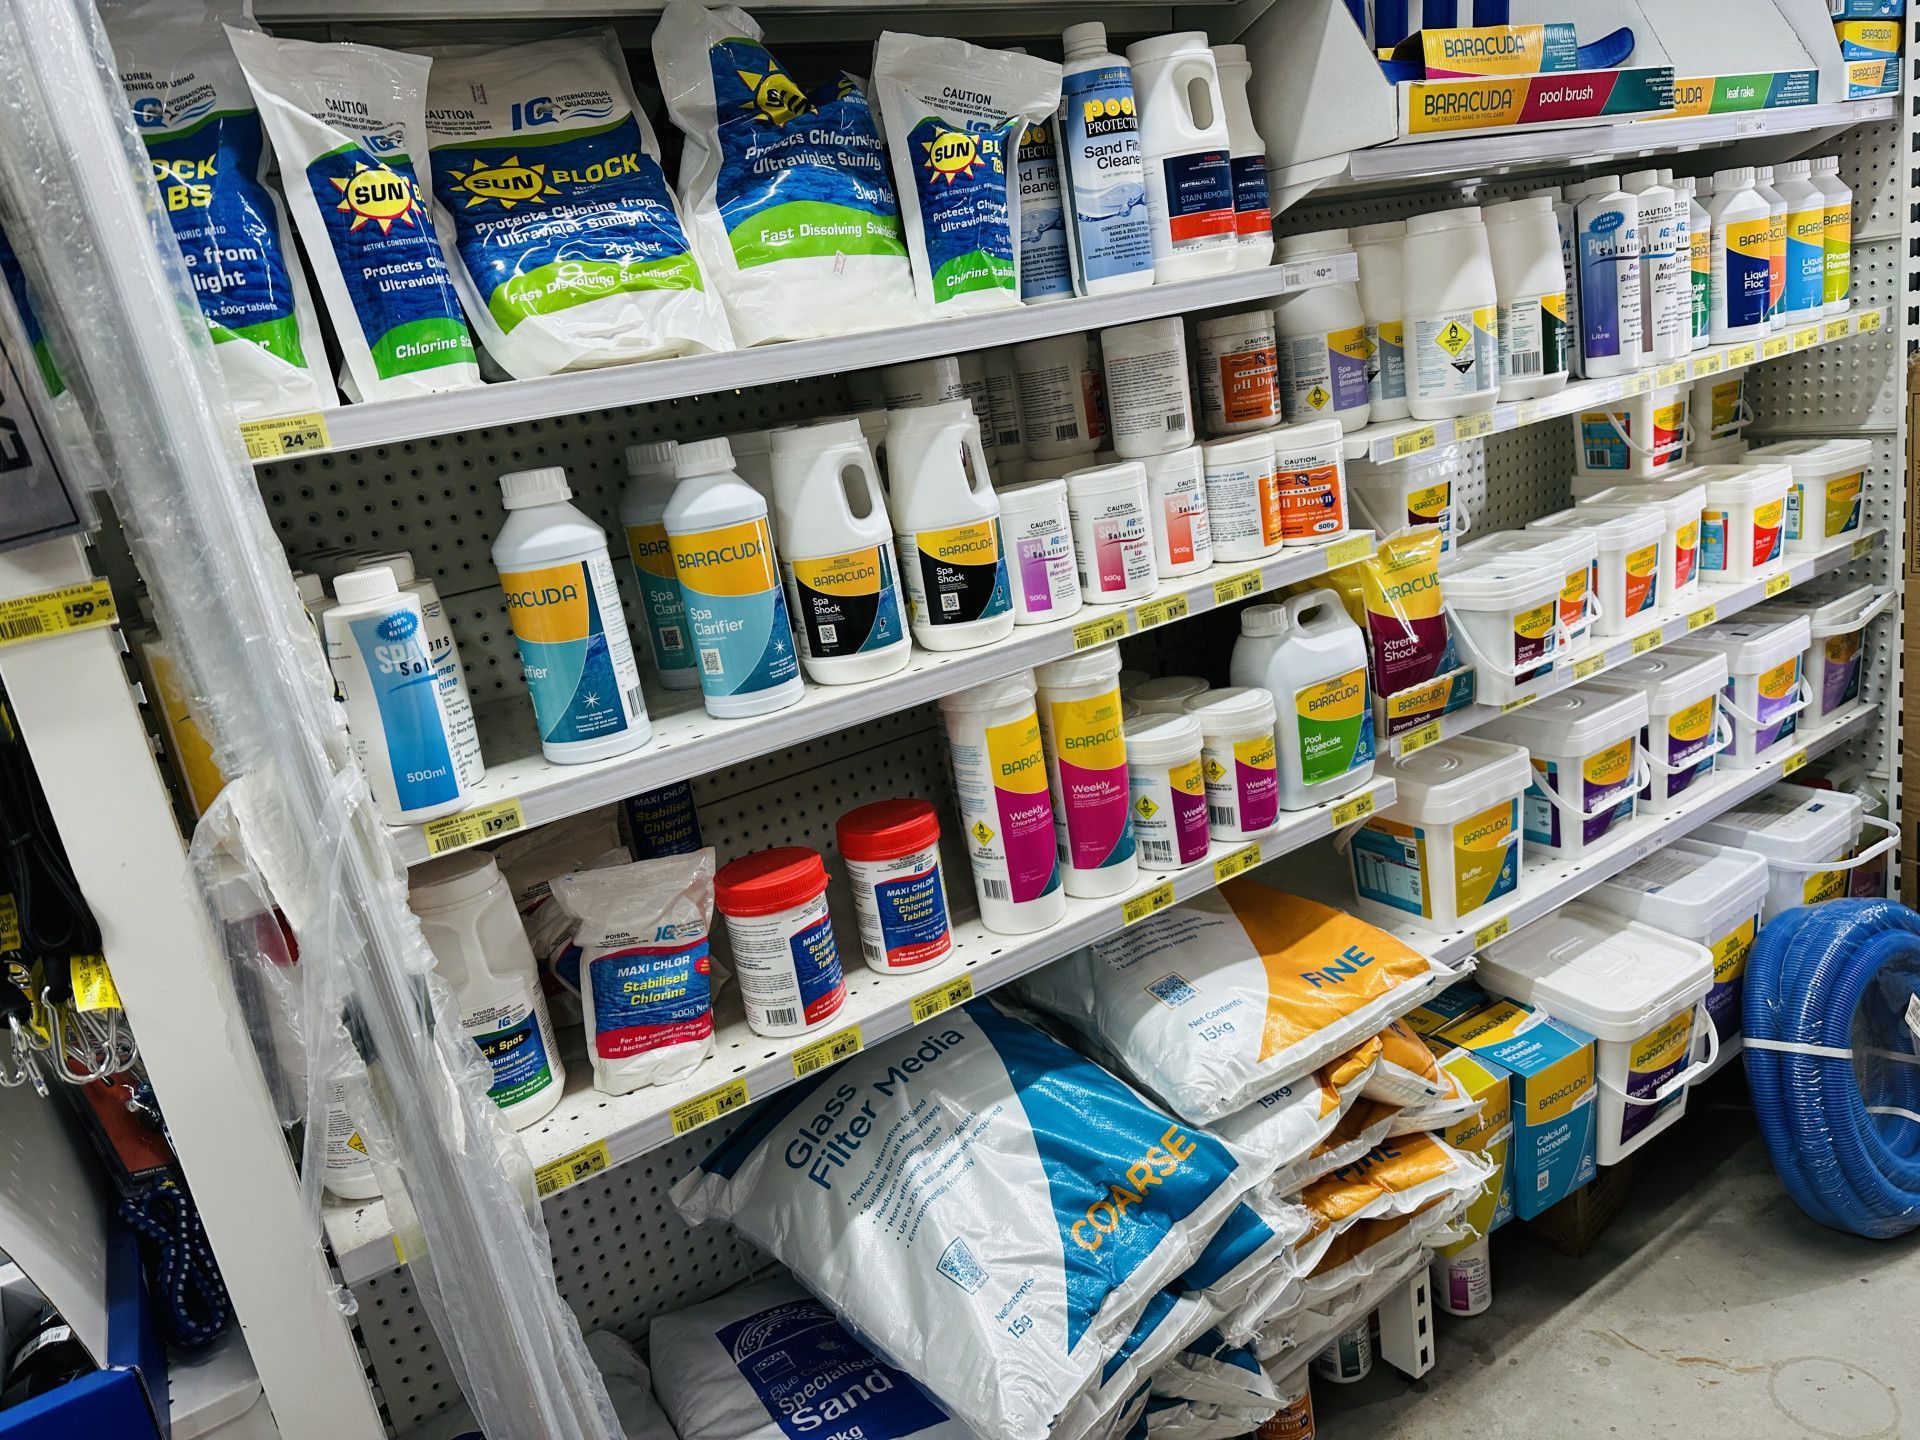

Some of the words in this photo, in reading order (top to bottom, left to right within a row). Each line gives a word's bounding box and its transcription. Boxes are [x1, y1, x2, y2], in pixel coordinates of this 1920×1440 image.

[1862, 29, 1892, 40] BARACUDA
[1445, 36, 1525, 58] BARACUDA
[1853, 66, 1881, 79] BARACUDA
[555, 90, 610, 102] INTERNATIONAL
[942, 86, 992, 105] CAUTION
[1425, 90, 1513, 116] BARACUDA
[1539, 90, 1563, 106] pool
[1566, 85, 1593, 101] brush
[1726, 86, 1738, 99] leaf
[1739, 86, 1755, 98] rake
[325, 98, 369, 117] CAUTION
[564, 96, 613, 108] QUADRATICS
[982, 106, 1007, 116] CHILDREN
[1441, 114, 1459, 122] TRUSTED
[1460, 113, 1473, 121] NAME
[935, 141, 970, 161] SUN
[1084, 143, 1122, 159] Sand
[473, 174, 534, 190] SUN
[552, 153, 641, 184] BLOCK
[753, 153, 836, 175] Ultraviolet
[354, 182, 405, 205] SUN
[1181, 191, 1203, 204] STAIN
[475, 210, 548, 235] Protects
[552, 201, 616, 222] Chlorine
[621, 196, 657, 211] from
[933, 205, 975, 222] Protects
[1638, 206, 1673, 218] CAUTION
[496, 223, 583, 248] Ultraviolet
[760, 227, 795, 244] Fast
[799, 222, 862, 238] Dissolving
[204, 246, 257, 264] from
[638, 241, 663, 253] Net
[363, 259, 424, 281] Protects
[1744, 269, 1768, 281] Liquid
[379, 273, 446, 293] Ultraviolet
[1744, 280, 1764, 290] Floc
[395, 337, 457, 359] Chlorine
[1233, 381, 1251, 394] pH
[283, 431, 318, 448] 24.99
[1284, 455, 1317, 466] CAUTION
[1107, 502, 1133, 512] CAUTION
[1299, 494, 1333, 508] Down
[1030, 518, 1057, 529] CAUTION
[1318, 521, 1335, 531] 500g
[1108, 526, 1145, 540] Solutions
[678, 538, 765, 570] BARACUDA
[938, 537, 993, 558] BARACUDA
[1033, 545, 1069, 559] Solutions
[813, 566, 875, 587] BARACUDA
[936, 567, 953, 576] Spa
[937, 571, 965, 584] Shock
[1104, 574, 1121, 584] 500g
[25, 591, 61, 603] TELEPOLE
[650, 590, 675, 602] Spa
[812, 597, 829, 607] Spa
[690, 607, 713, 621] Spa
[814, 602, 841, 614] Shock
[694, 618, 745, 635] Clarifier
[1520, 616, 1551, 634] BARACUDA
[1383, 634, 1419, 652] Xtreme
[375, 640, 420, 674] SPA
[1384, 645, 1418, 662] Shock
[1309, 684, 1359, 714] BARACUDA
[1398, 687, 1446, 712] BARACUDA
[1392, 717, 1413, 732] Xtreme
[1413, 712, 1431, 726] Shock
[1304, 733, 1322, 746] Pool
[1305, 735, 1342, 755] Algaecide
[407, 766, 446, 784] 500ml
[1246, 777, 1272, 791] Weekly
[1071, 780, 1111, 798] Weekly
[1074, 788, 1100, 801] Chlorine
[1009, 803, 1044, 823] Weekly
[1011, 813, 1037, 828] Chlorine
[486, 814, 515, 832] 19.99
[1463, 817, 1508, 845] BARACUDA
[1462, 866, 1483, 881] Buffer
[886, 886, 910, 898] MAXI
[912, 876, 935, 892] CHLOR
[892, 887, 935, 907] Stabilised
[898, 897, 933, 914] Chlorine
[902, 907, 934, 923] Tablets
[605, 932, 630, 941] POISON
[617, 963, 650, 978] MAXI
[653, 955, 690, 972] CHLOR
[1299, 945, 1377, 990] FINE
[623, 971, 690, 994] Stabilised
[630, 986, 687, 1006] Chlorine
[672, 1007, 695, 1020] 500g
[1188, 1015, 1206, 1029] Net
[1205, 997, 1244, 1020] Contents
[1198, 1020, 1236, 1042] 15kg
[1461, 1009, 1516, 1042] BARACUDA
[500, 1034, 525, 1051] Spot
[620, 1036, 632, 1045] For
[635, 1035, 647, 1043] the
[1493, 1038, 1528, 1059] Calcium
[1636, 1028, 1688, 1067] BARACUDA
[1502, 1041, 1544, 1063] Increaser
[1650, 1066, 1675, 1086] Action
[1539, 1075, 1588, 1111] BARACUDA
[808, 1099, 877, 1190] Filter
[873, 1030, 965, 1097] Media
[784, 1083, 857, 1170] Glass
[1536, 1122, 1569, 1147] Calcium
[851, 1169, 877, 1202] Perfect
[874, 1121, 903, 1170] alternative
[909, 1098, 928, 1119] Sand
[1536, 1130, 1572, 1157] Increaser
[863, 1173, 889, 1211] Suitable
[917, 1104, 942, 1130] Filters
[875, 1179, 901, 1220] Reduces
[922, 1124, 943, 1147] costs
[1070, 1124, 1199, 1254] COARSE
[887, 1201, 903, 1228] More
[791, 1368, 895, 1432] Sand
